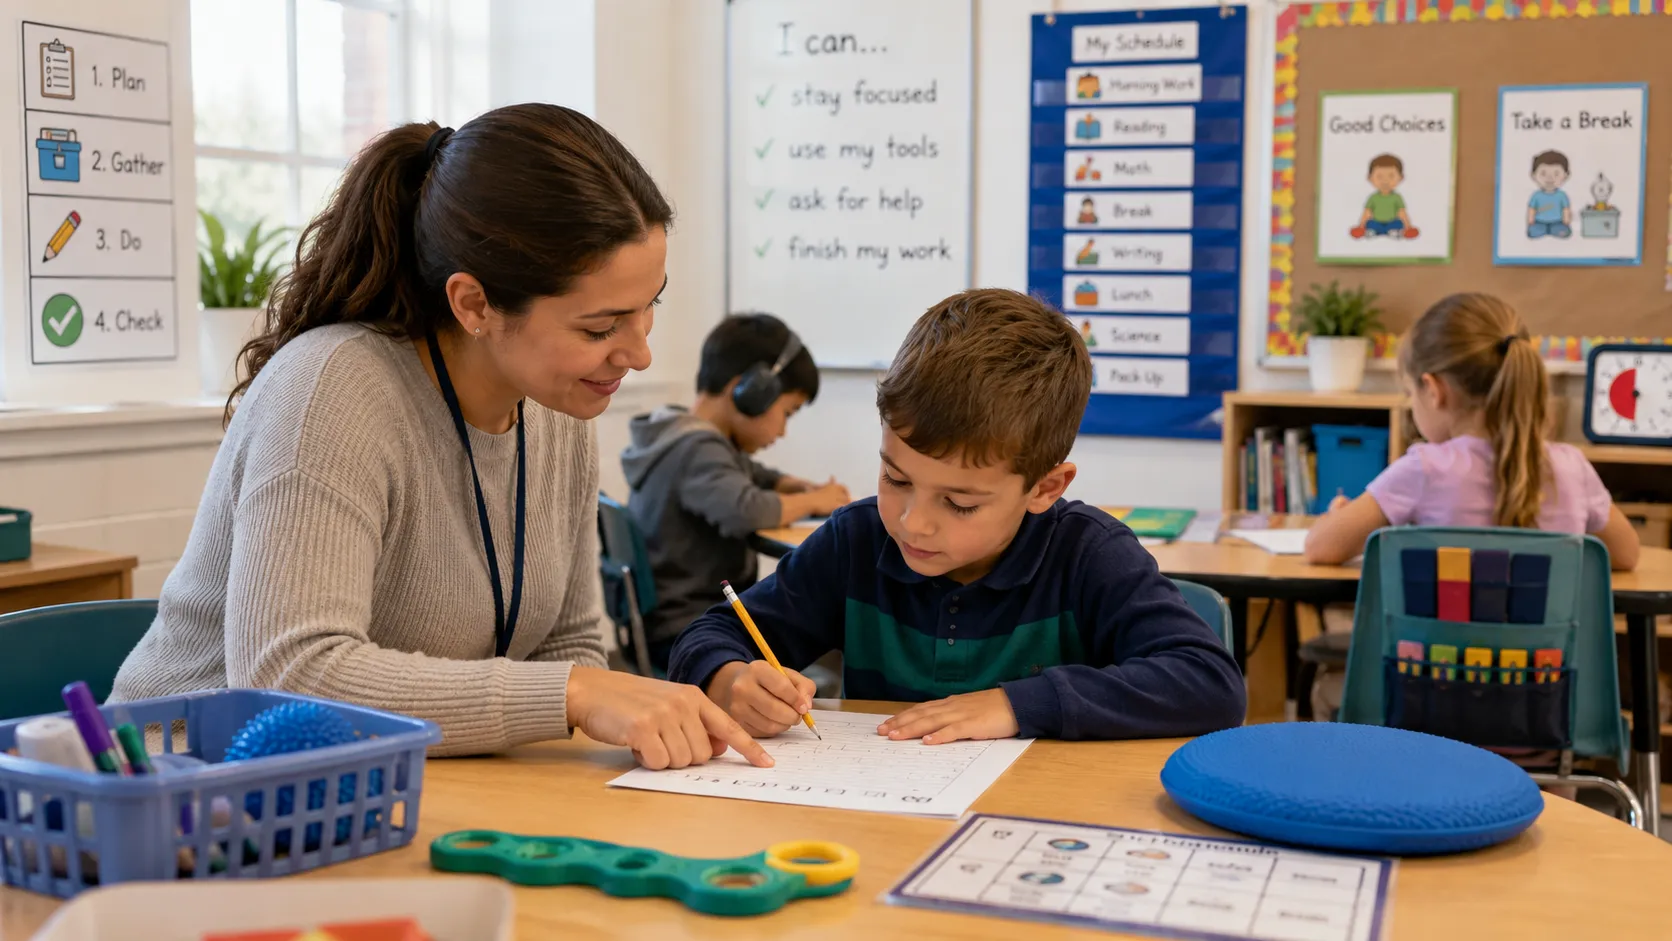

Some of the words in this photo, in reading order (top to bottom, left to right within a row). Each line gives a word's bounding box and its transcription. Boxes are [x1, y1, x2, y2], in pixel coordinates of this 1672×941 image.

[777, 20, 795, 56] I
[804, 33, 887, 55] can...
[91, 64, 102, 86] 1.
[111, 66, 145, 90] Plan
[791, 82, 842, 118] stay
[853, 79, 937, 104] focused
[1328, 115, 1374, 134] Good
[1378, 114, 1445, 133] Choices
[1511, 111, 1552, 130] Take
[1559, 116, 1571, 129] a
[1578, 110, 1632, 128] Break
[91, 149, 106, 171] 2.
[110, 150, 164, 175] Gather
[789, 143, 826, 159] use
[839, 144, 874, 169] my
[886, 134, 939, 158] tools
[789, 188, 826, 212] ask
[836, 186, 868, 211] for
[878, 188, 923, 219] help
[96, 228, 111, 250] 3.
[119, 228, 141, 251] Do
[788, 236, 847, 260] finish
[856, 245, 889, 269] my
[899, 239, 951, 260] work
[95, 311, 111, 332] 4.
[115, 309, 163, 331] Check
